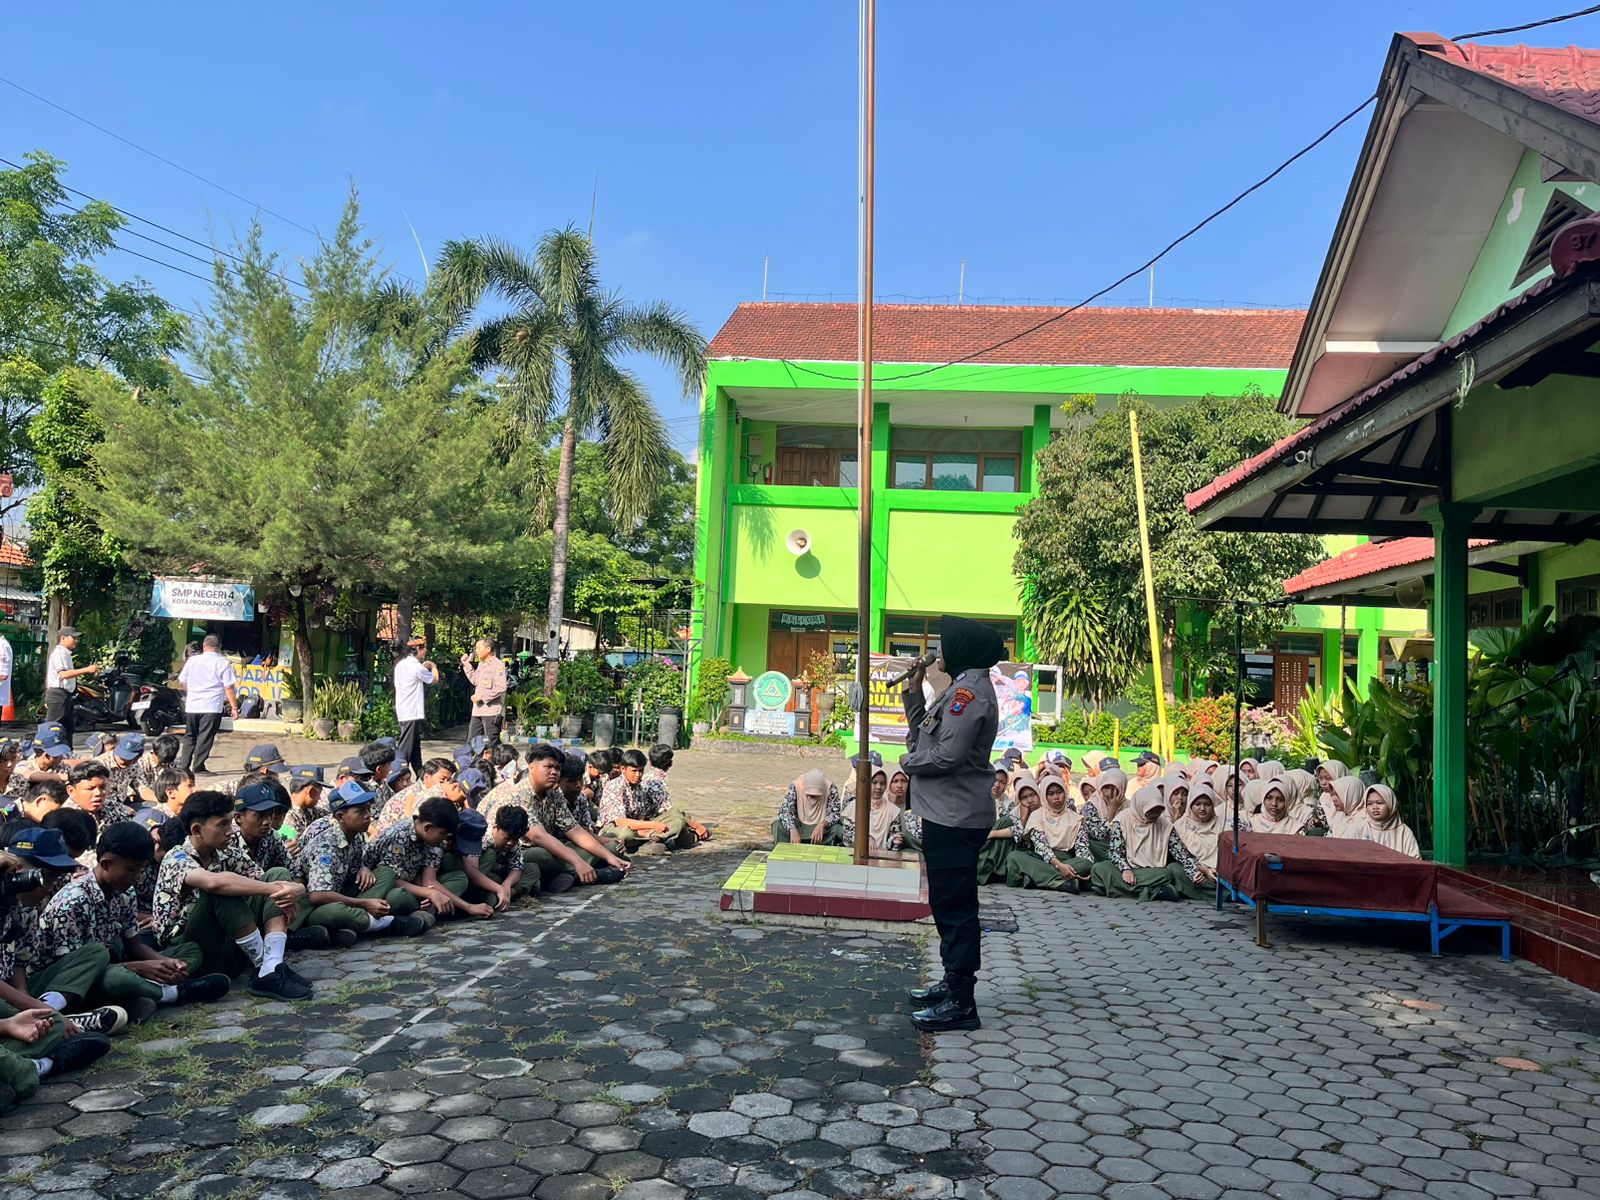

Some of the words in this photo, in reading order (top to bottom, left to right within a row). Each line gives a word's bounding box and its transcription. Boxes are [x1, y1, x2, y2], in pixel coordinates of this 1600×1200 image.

[171, 588, 192, 598] SMP
[193, 589, 227, 599] NEGERI
[228, 591, 235, 600] 4
[782, 614, 825, 624] WELCOME
[869, 694, 905, 707] BULL
